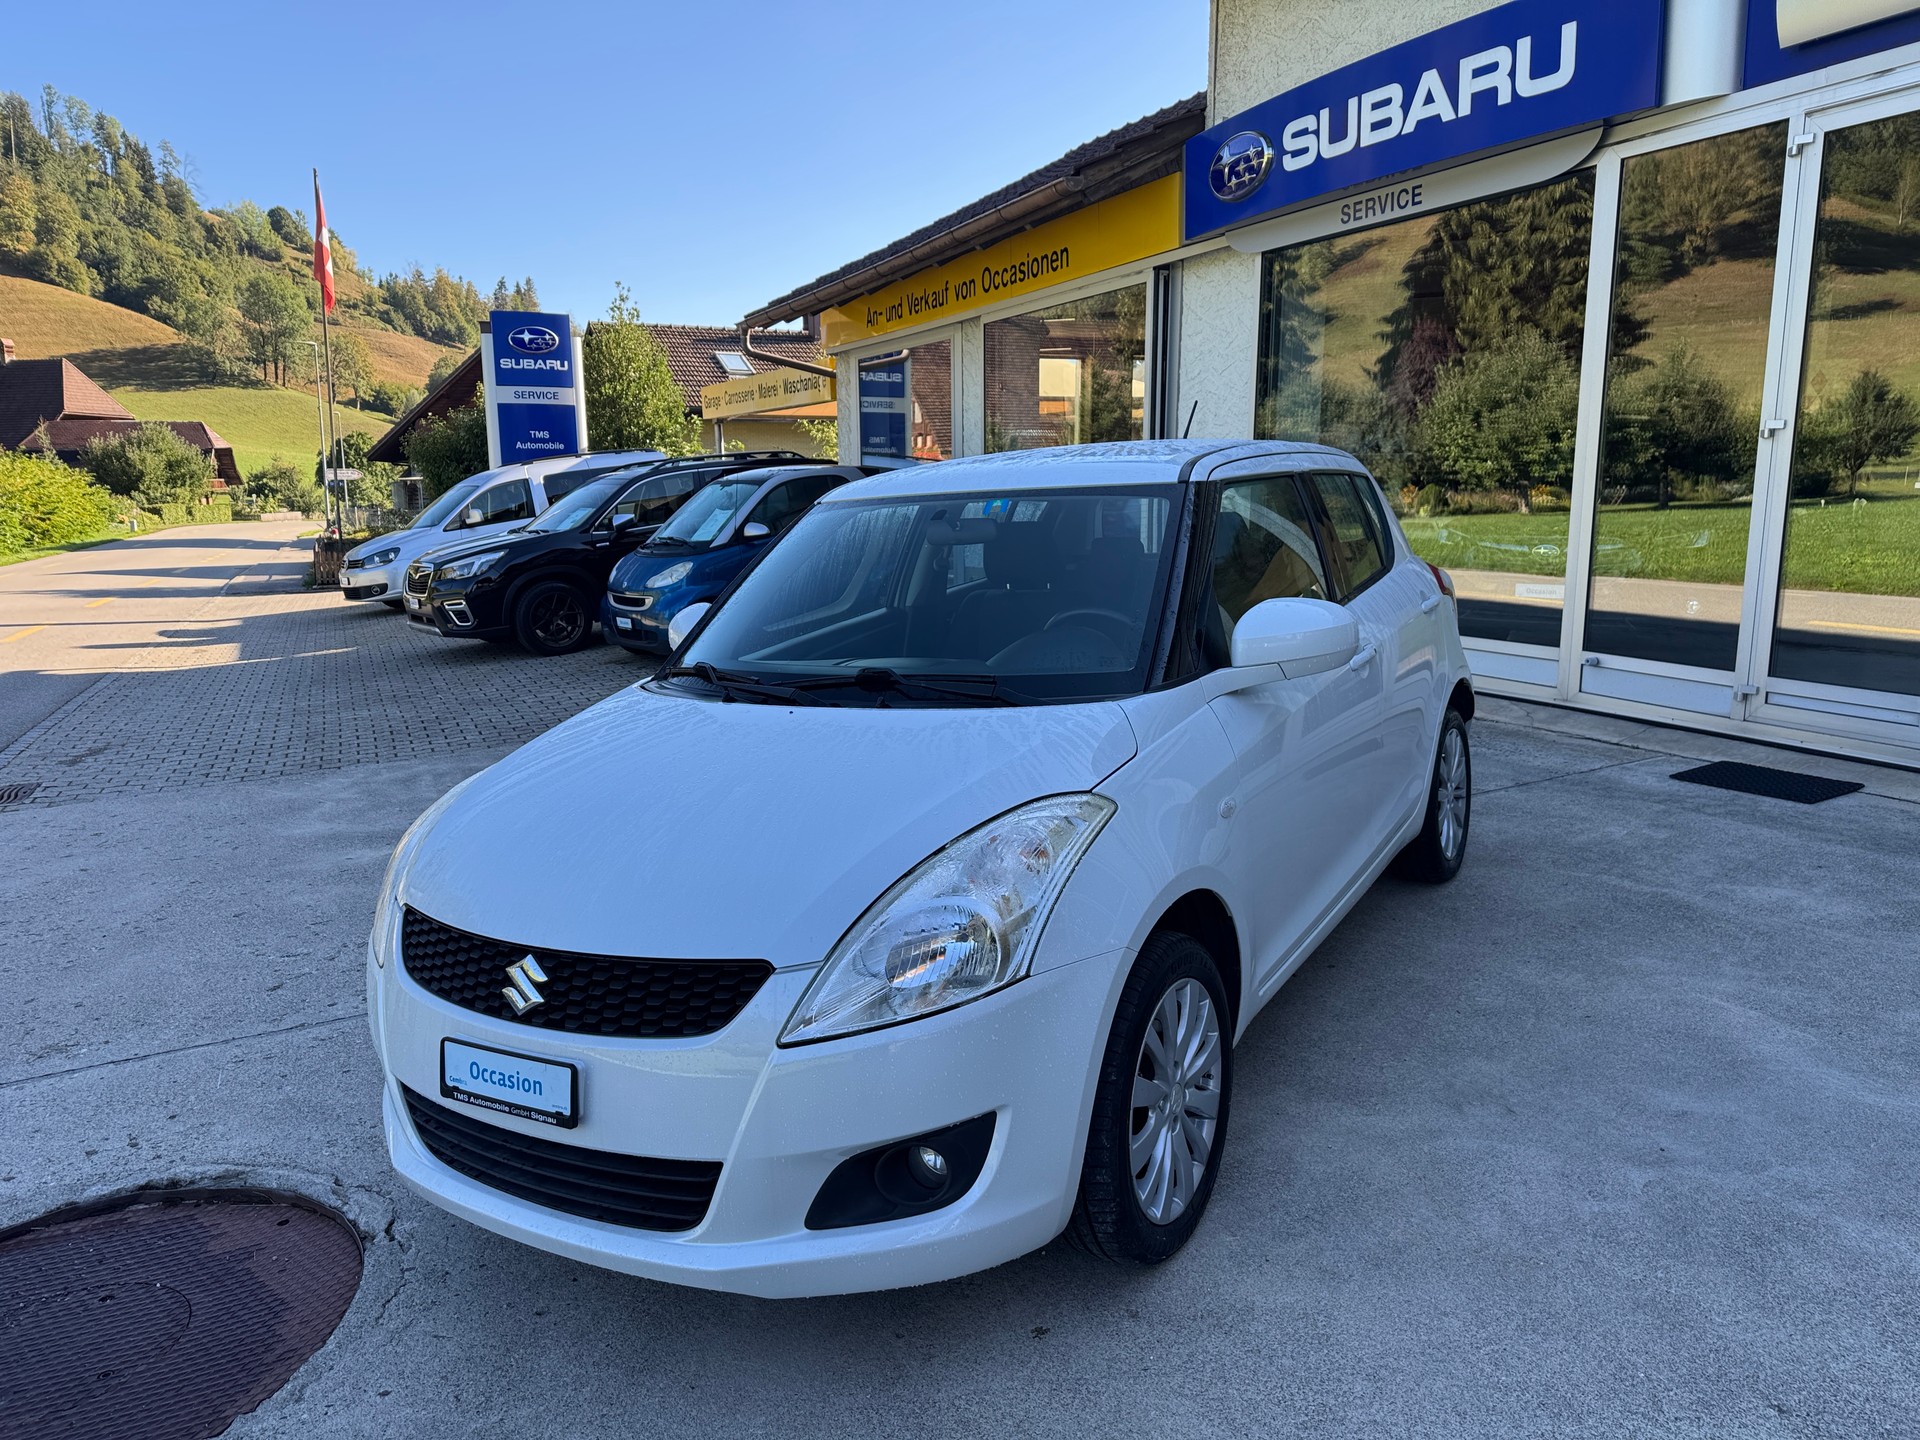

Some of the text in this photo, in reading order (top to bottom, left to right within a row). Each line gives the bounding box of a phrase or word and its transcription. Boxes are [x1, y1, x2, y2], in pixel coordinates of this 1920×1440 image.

[1282, 20, 1577, 172] SUBARU
[1340, 183, 1423, 225] SERVICE
[866, 246, 1069, 329] An- und Verkauf von Occasionen
[500, 358, 568, 371] SUBARU
[513, 390, 559, 400] SERVICE
[703, 394, 721, 410] Garage
[723, 386, 755, 406] Carrosserie
[758, 380, 778, 399] Malerei
[515, 441, 565, 450] Automobile
[529, 430, 549, 439] TMS
[469, 1061, 543, 1096] Occasion
[452, 1091, 557, 1124] TMS Automobile GmbH Signau
